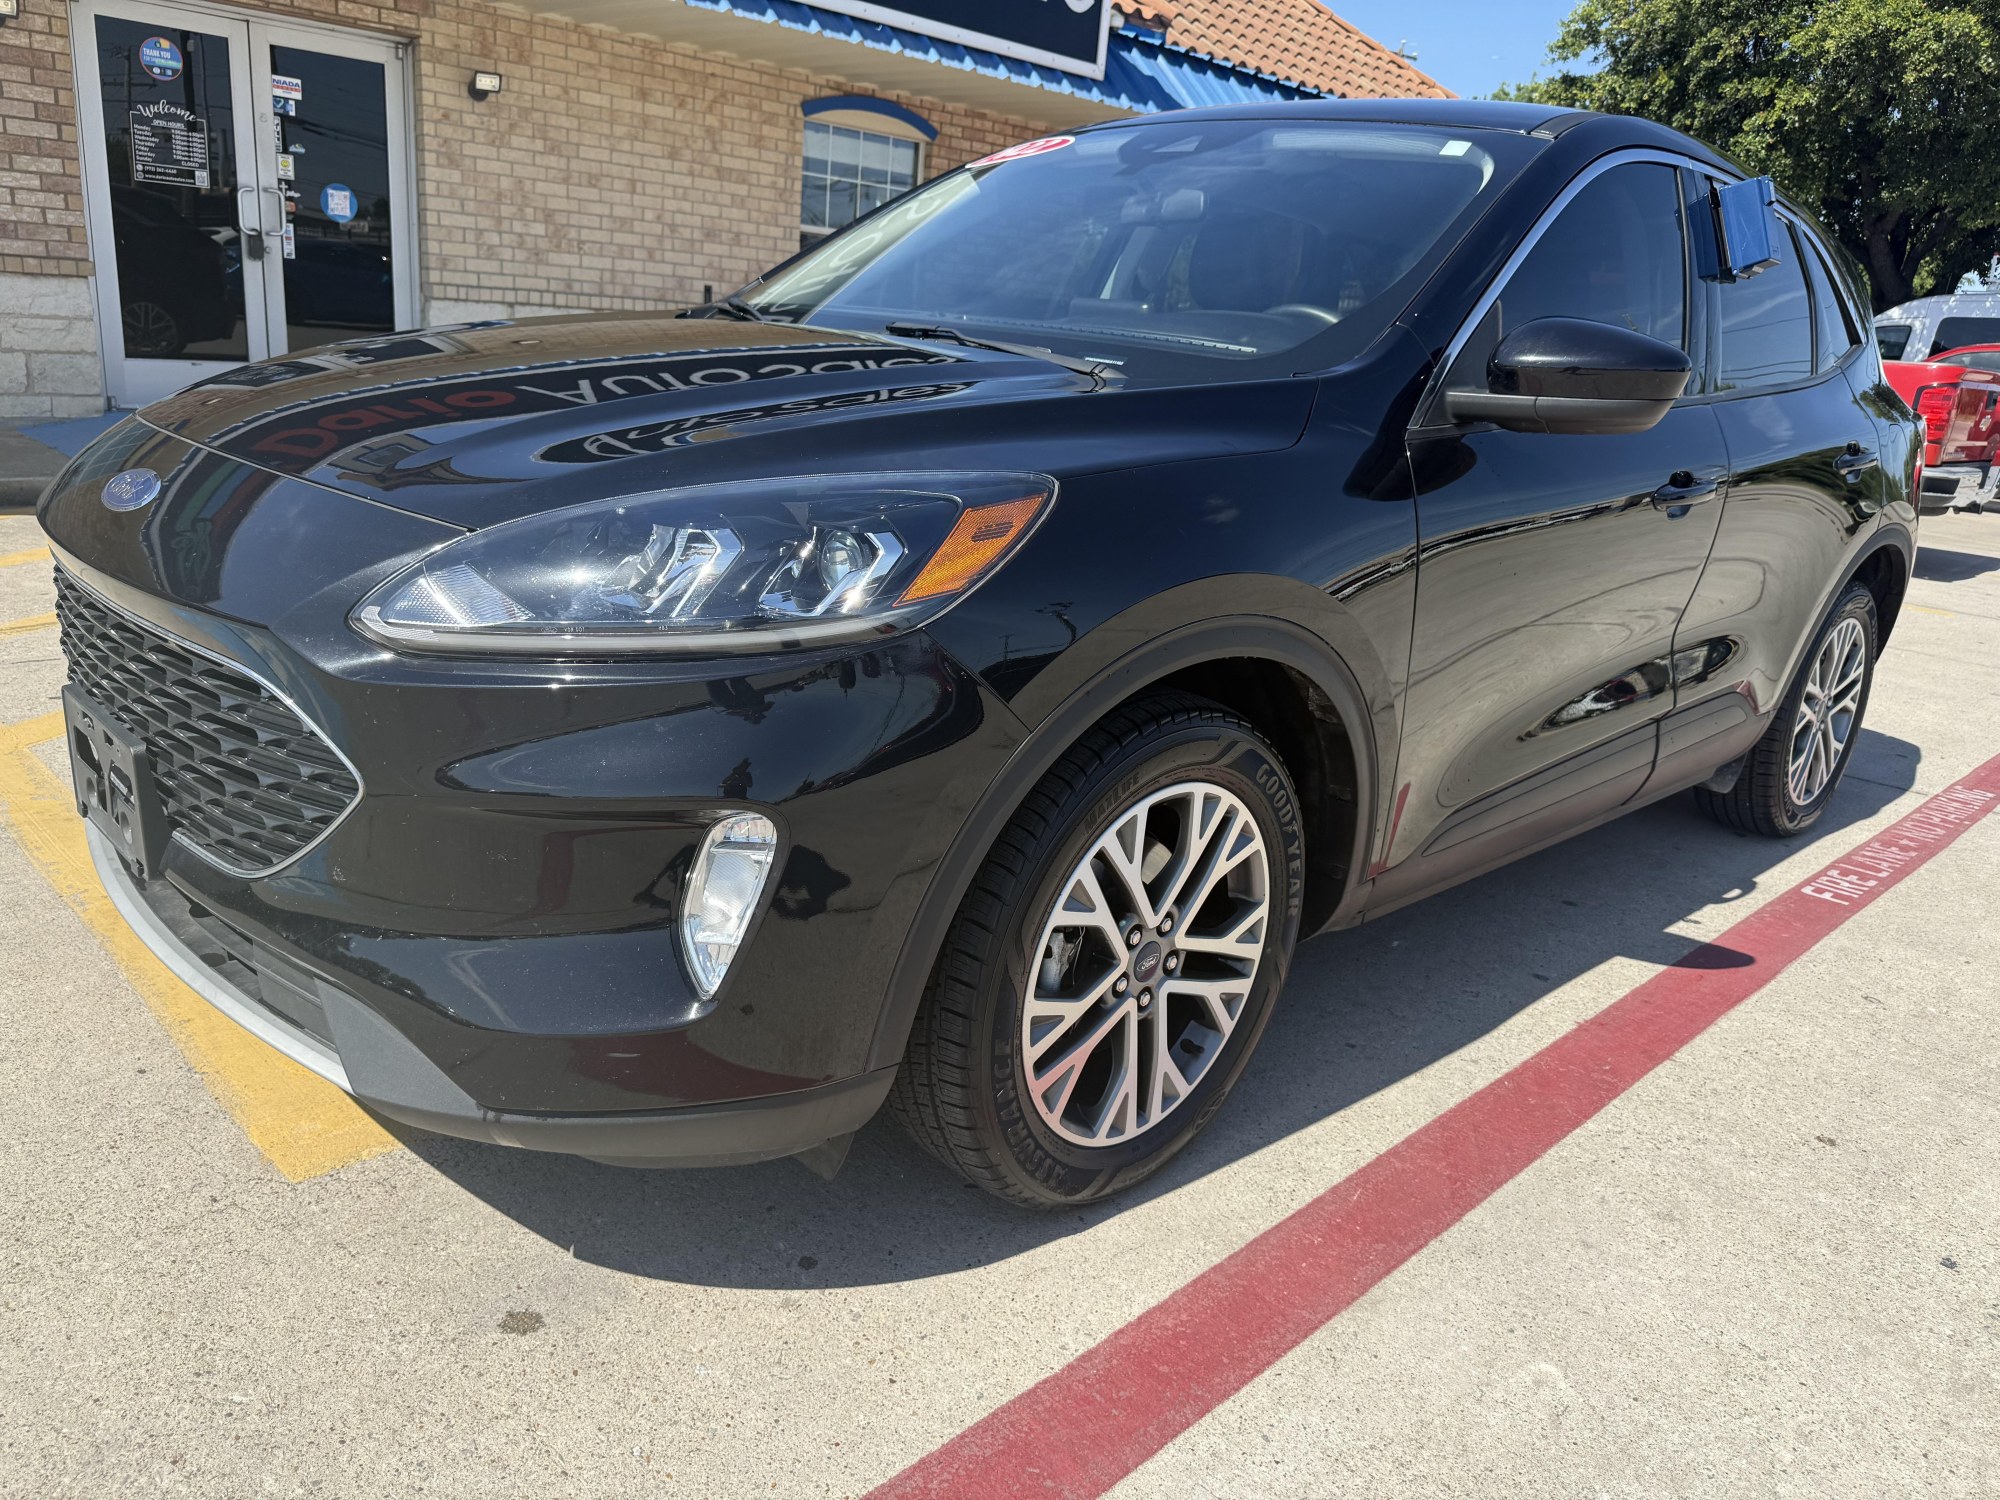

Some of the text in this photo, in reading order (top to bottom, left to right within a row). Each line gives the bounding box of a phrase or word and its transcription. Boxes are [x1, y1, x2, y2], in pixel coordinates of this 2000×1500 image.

[143, 47, 171, 59] THANK YOU
[272, 79, 300, 88] NIADA
[137, 99, 196, 121] Welcome
[133, 123, 151, 131] Monday
[168, 121, 185, 129] HOURS
[134, 135, 160, 143] Wednesday
[135, 140, 155, 148] Thursday
[135, 150, 155, 158] Saturday
[136, 155, 152, 163] Sunday
[1255, 763, 1300, 917] GOODYEAR
[1800, 785, 1997, 906] FIRE LANE NO PARKING
